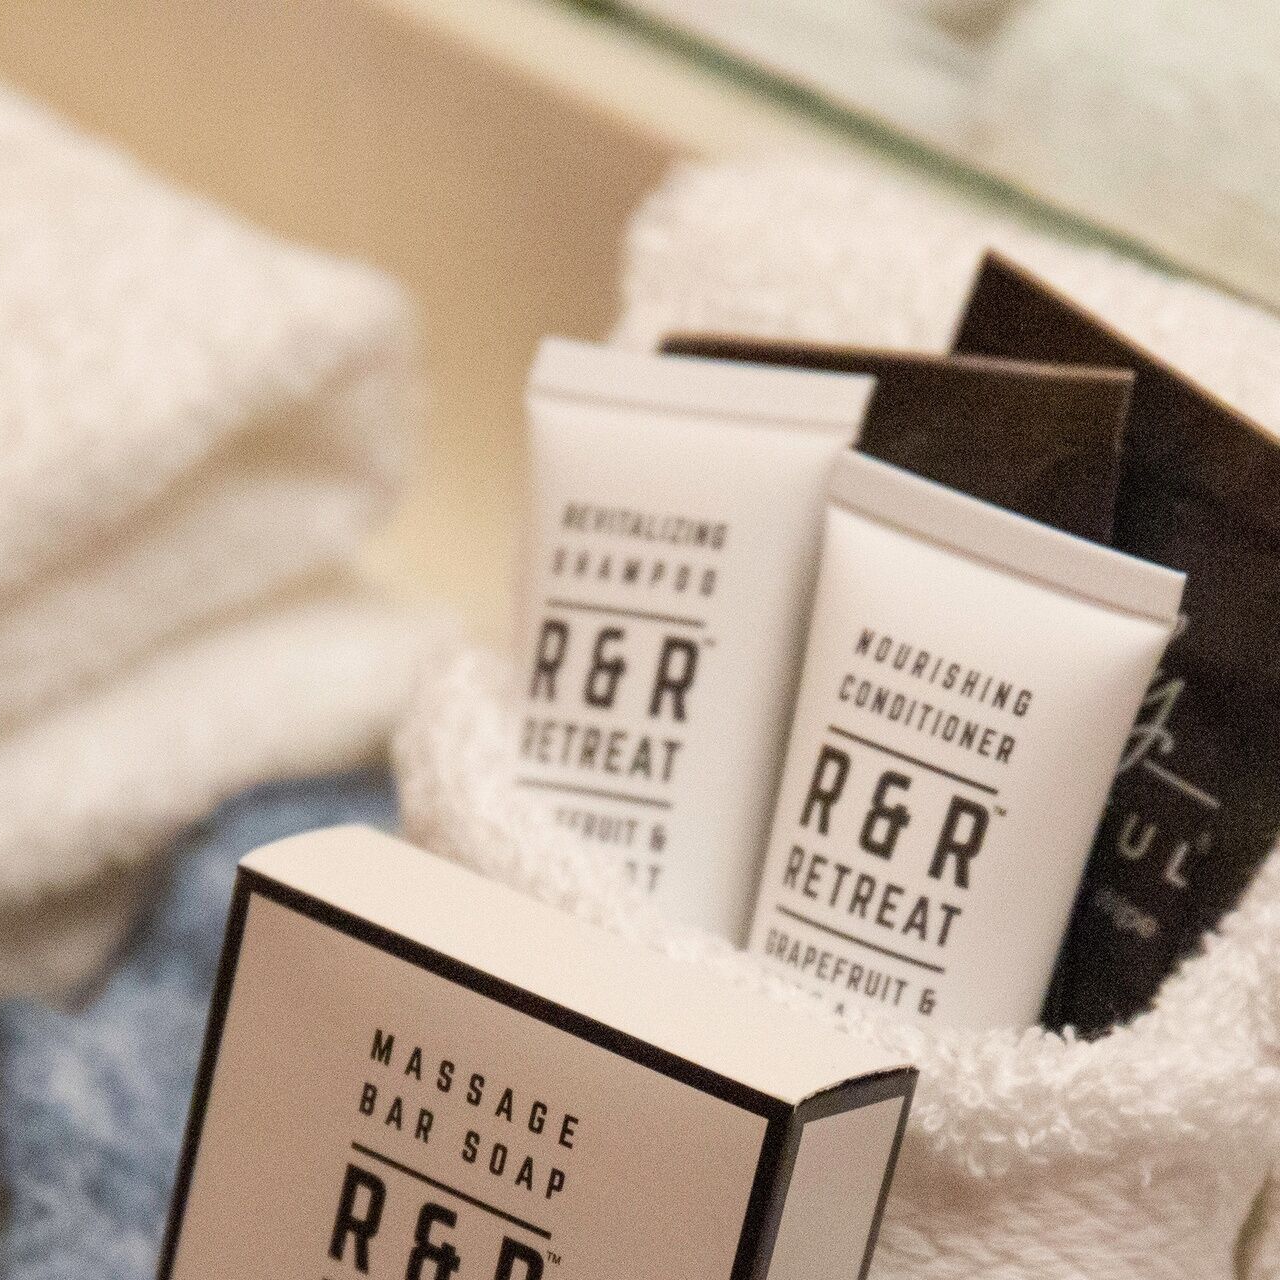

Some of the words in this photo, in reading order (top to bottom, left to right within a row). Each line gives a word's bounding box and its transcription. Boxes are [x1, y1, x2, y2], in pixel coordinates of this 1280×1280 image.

[838, 672, 1017, 766] CONDITIONER
[855, 627, 1033, 718] NOURISHING
[521, 716, 683, 784] RETREAT
[783, 845, 962, 948] RETREAT
[765, 927, 908, 1006] GRAPEFRUIT
[370, 1028, 578, 1150] MASSAGE
[360, 1081, 434, 1145] BAR
[461, 1129, 567, 1201] SOAP
